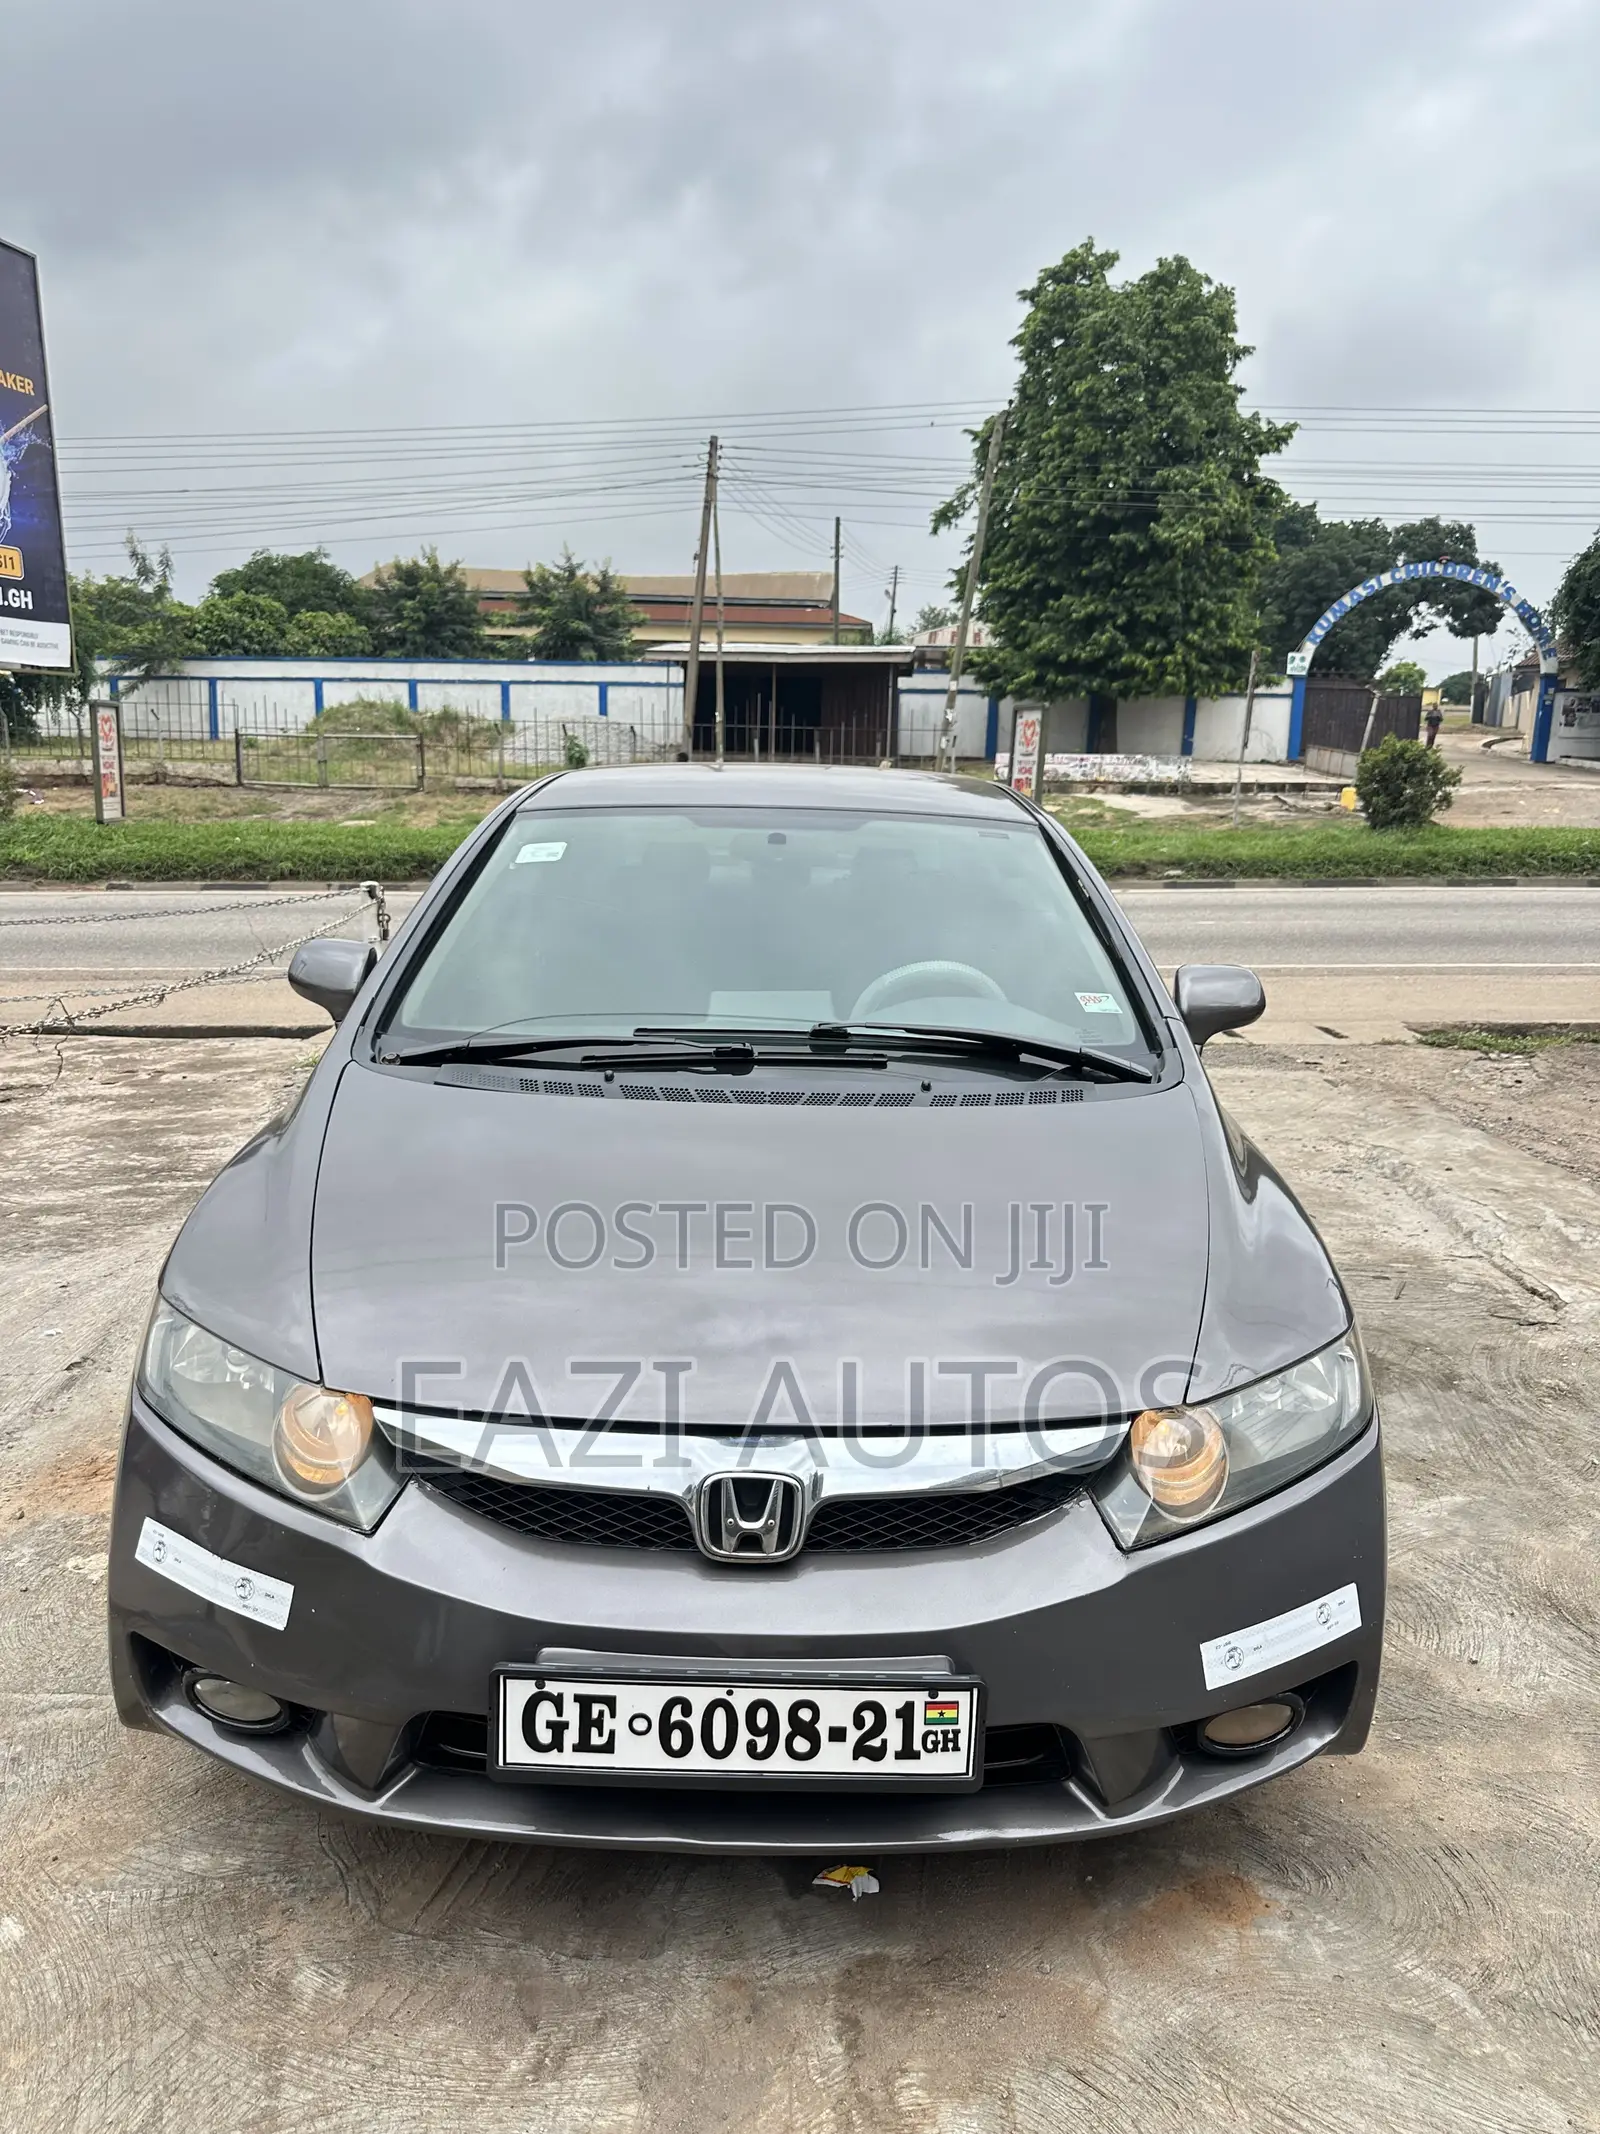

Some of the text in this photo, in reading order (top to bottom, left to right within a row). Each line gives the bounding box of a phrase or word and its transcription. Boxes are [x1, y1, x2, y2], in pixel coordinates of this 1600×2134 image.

[1305, 560, 1557, 661] KUMASI CHILDREN'S HOME
[522, 1690, 921, 1762] GE 6098-21
[922, 1728, 961, 1754] GH
